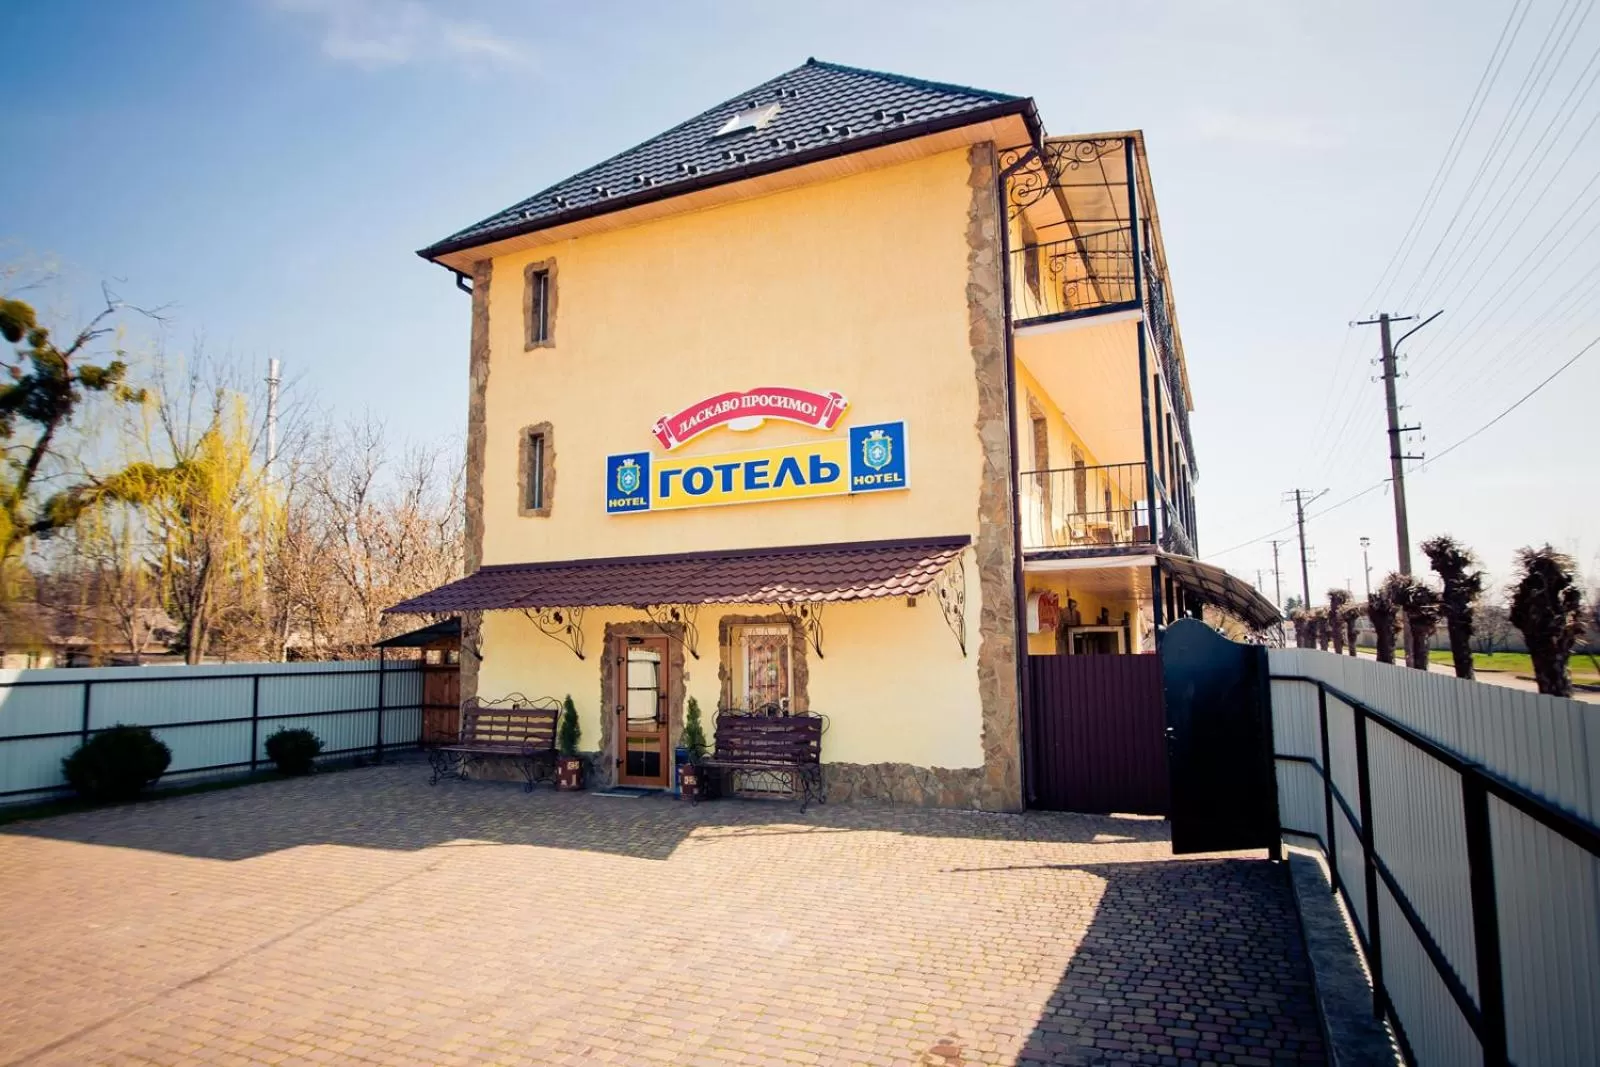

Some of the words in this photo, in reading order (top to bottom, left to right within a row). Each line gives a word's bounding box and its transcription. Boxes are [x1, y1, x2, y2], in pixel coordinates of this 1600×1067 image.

[679, 398, 740, 434] ЛАСКАВО
[741, 395, 817, 416] ПРОСИМО!
[660, 455, 841, 497] ГОТЕЛЬ
[853, 472, 903, 485] HOTEL
[608, 497, 648, 508] HOTEL
